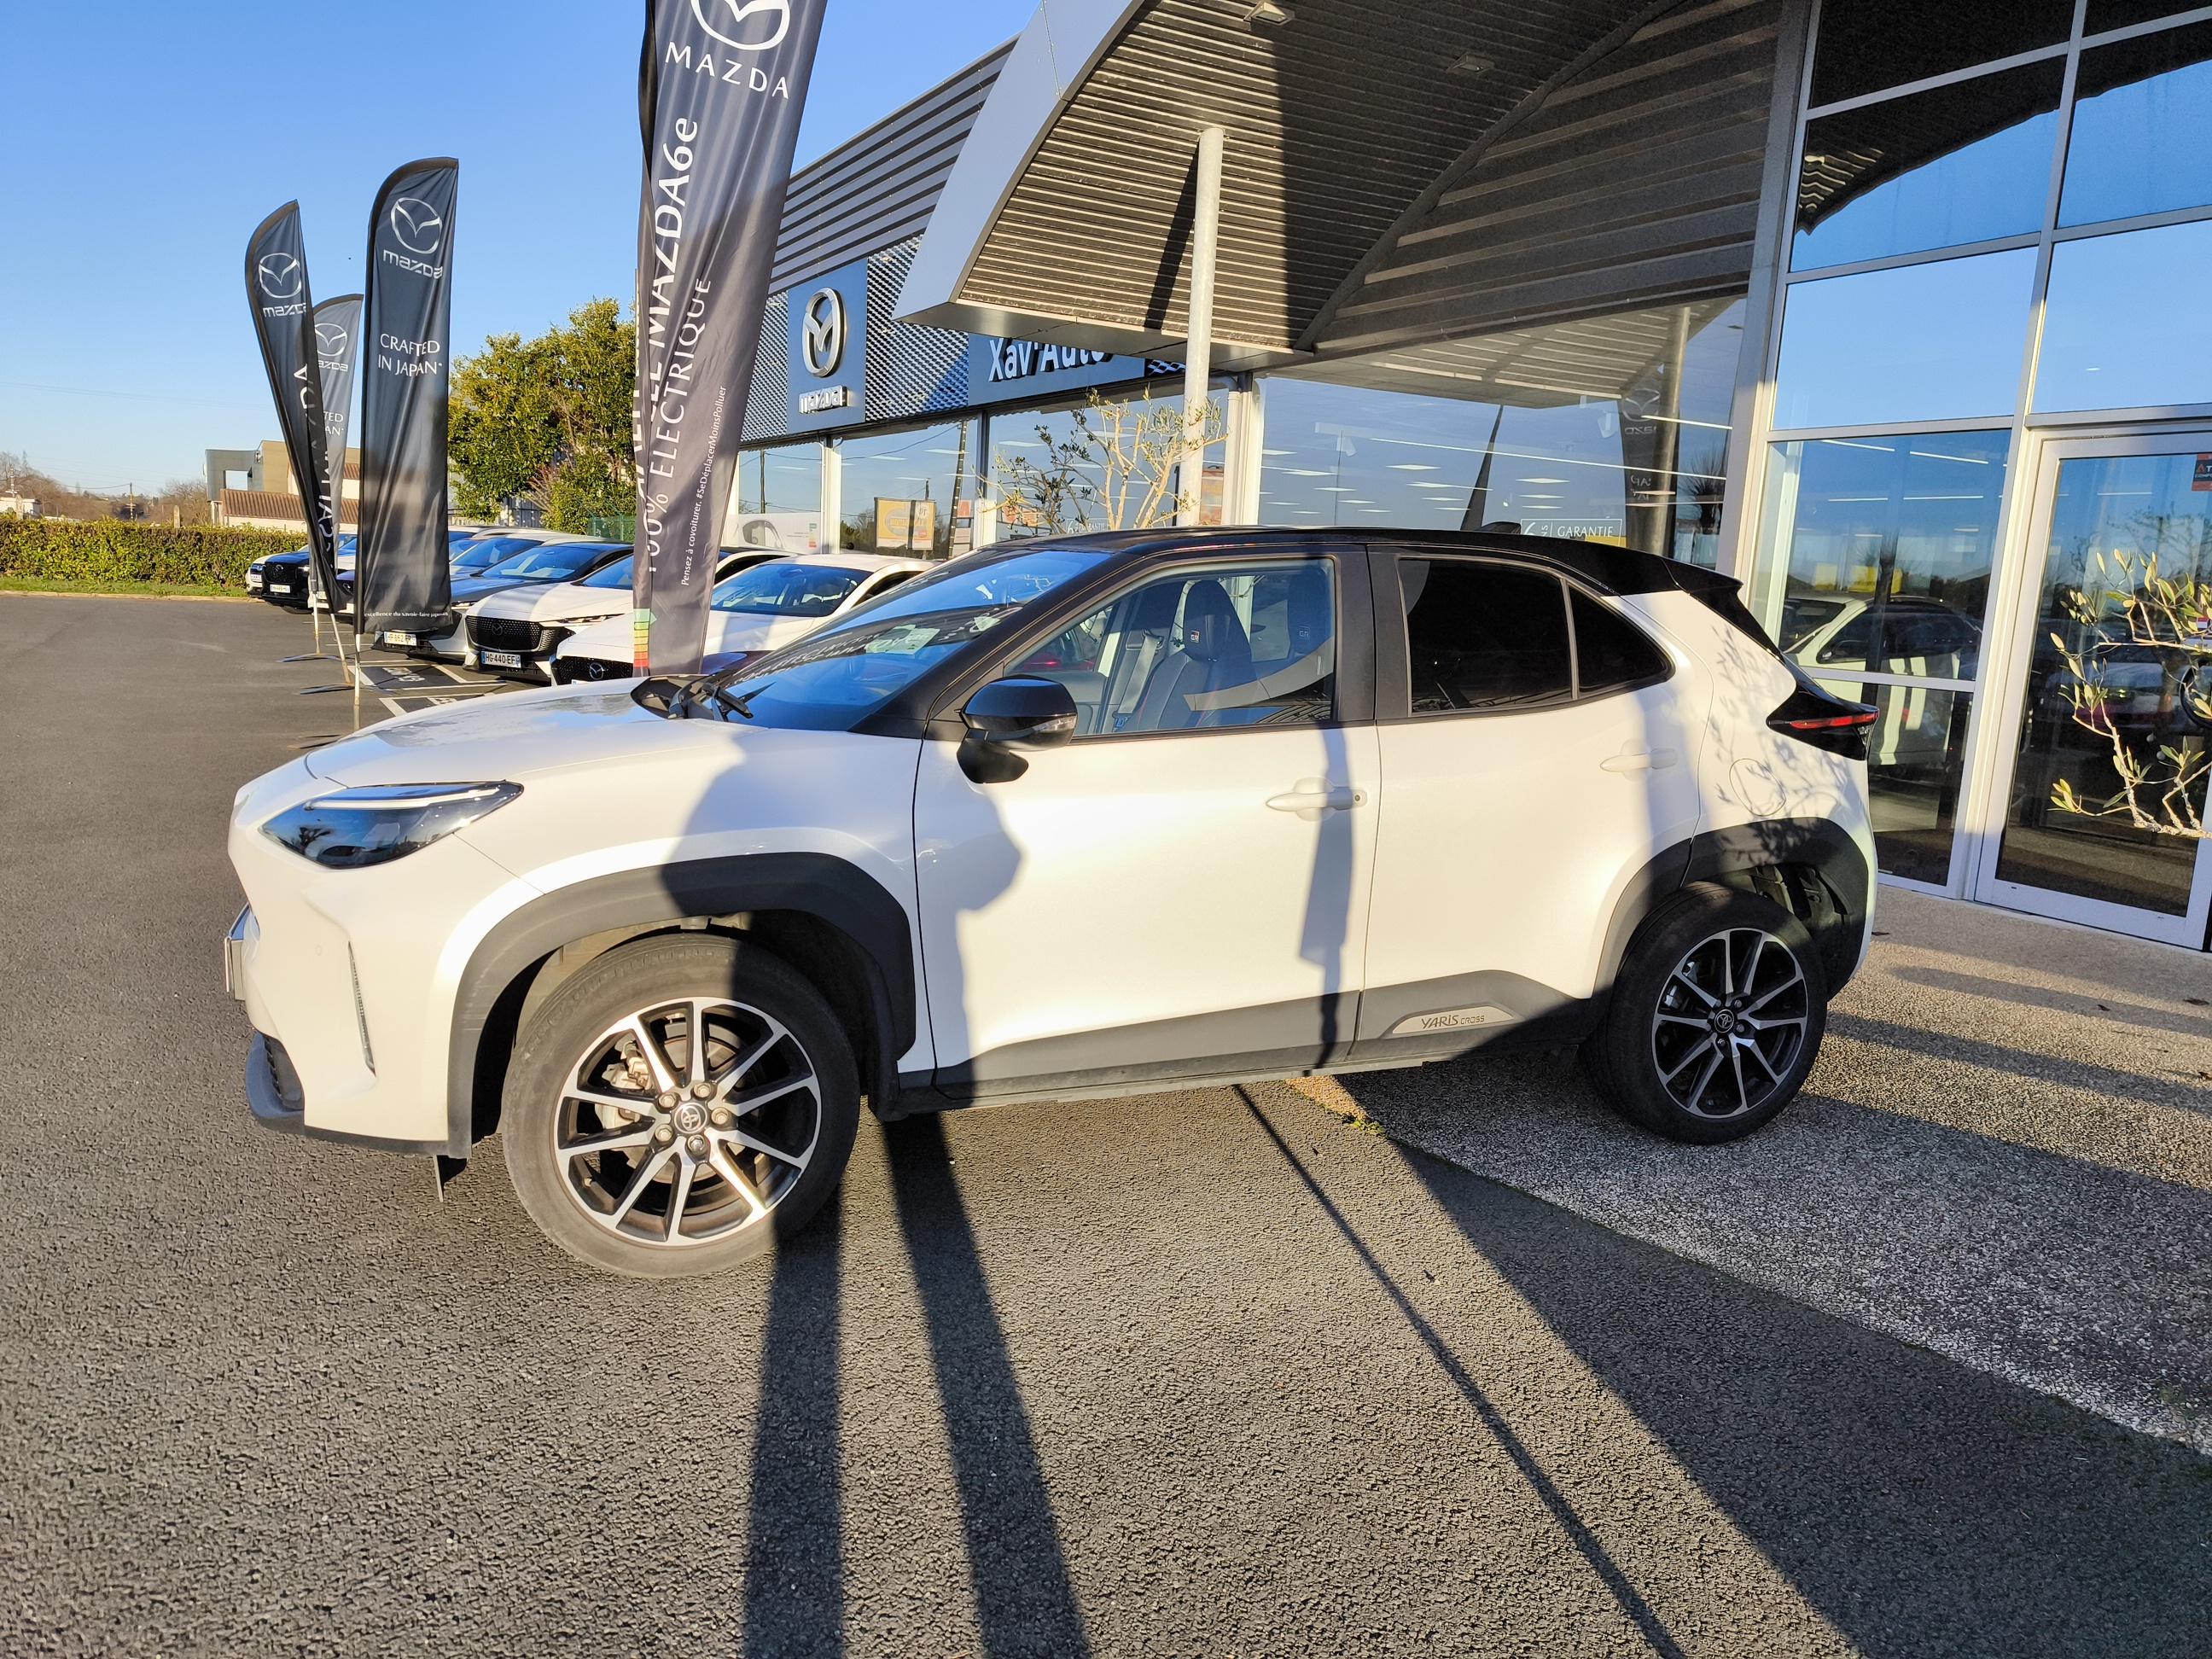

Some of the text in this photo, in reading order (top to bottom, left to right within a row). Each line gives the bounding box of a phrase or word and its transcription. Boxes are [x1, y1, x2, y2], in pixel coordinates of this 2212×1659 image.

[665, 41, 789, 100] MAZDA
[383, 248, 444, 280] mazda
[380, 333, 441, 358] CRAFTED
[988, 337, 1107, 382] Xav'Auto
[317, 359, 349, 373] azda
[378, 354, 439, 378] IN JAPAN
[649, 278, 711, 479] ELECTRIQUE
[799, 386, 843, 415] mazda
[689, 501, 703, 547] covoiturer.
[1557, 526, 1615, 538] GARANTIE
[685, 544, 694, 556] à
[681, 556, 694, 586] Pensez
[1421, 1015, 1485, 1029] YARIS CROSS
